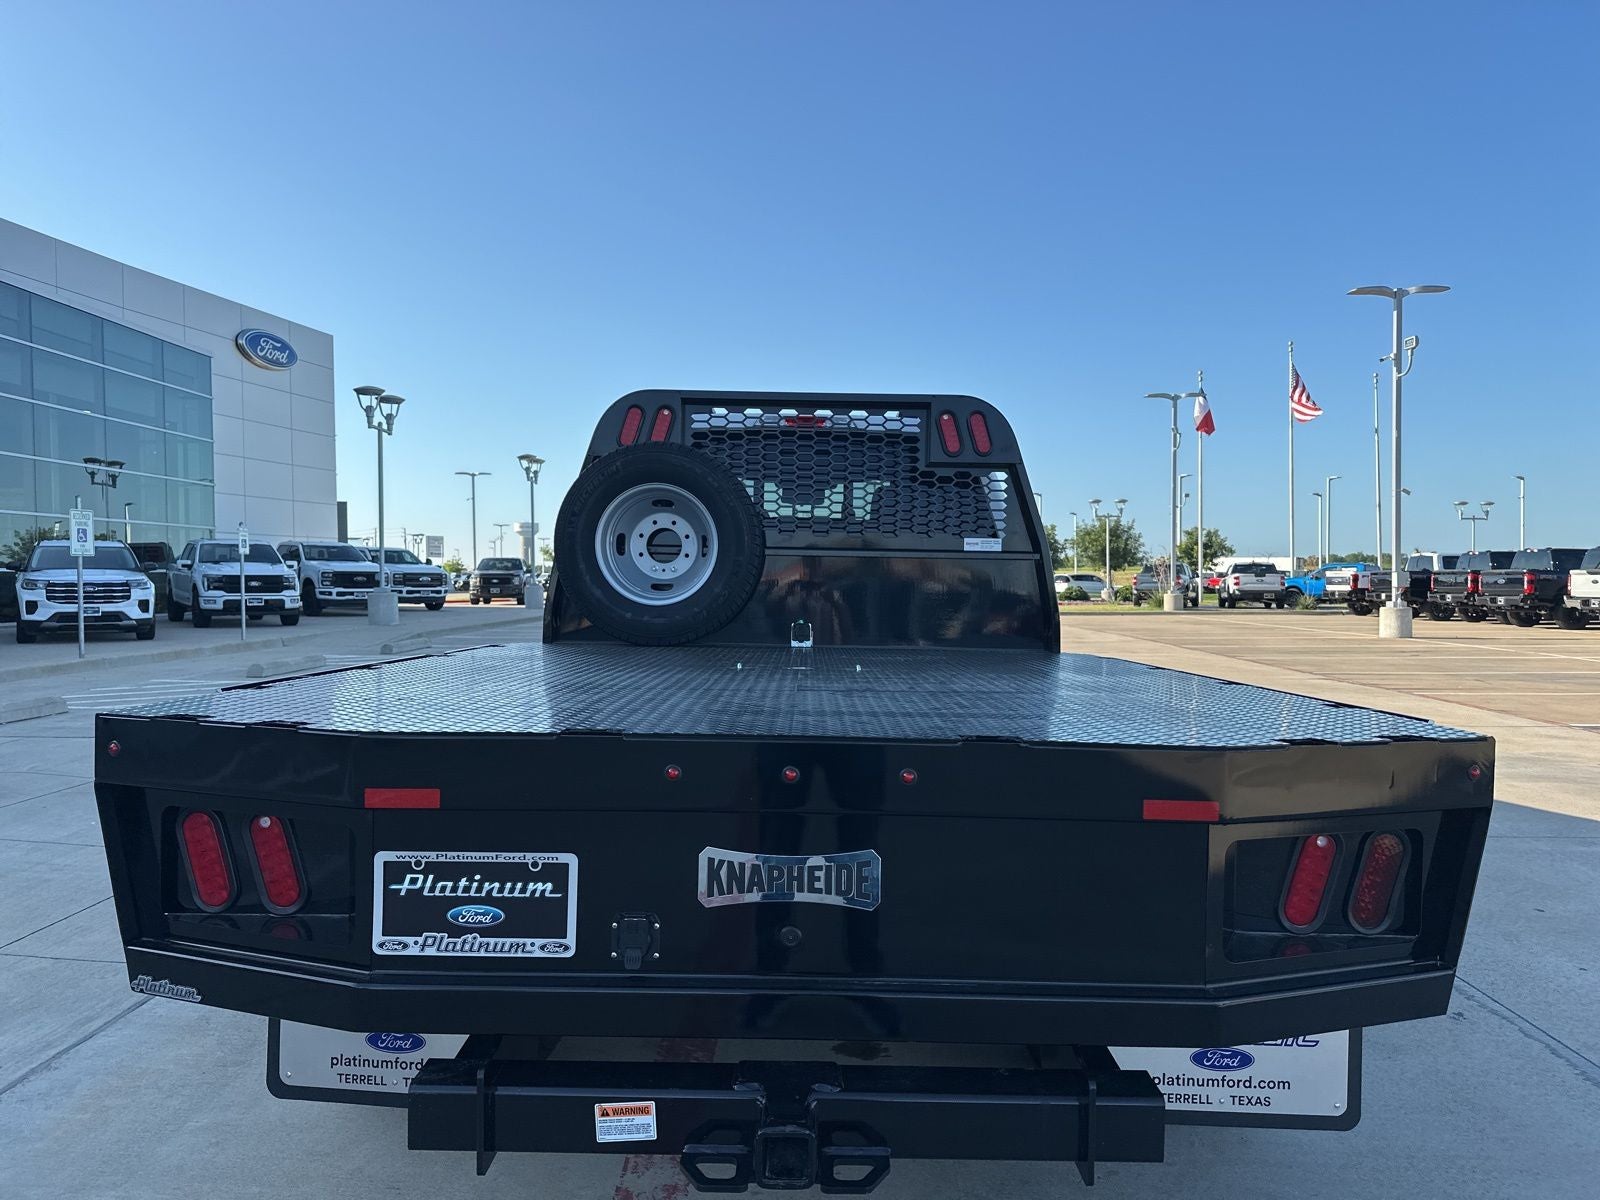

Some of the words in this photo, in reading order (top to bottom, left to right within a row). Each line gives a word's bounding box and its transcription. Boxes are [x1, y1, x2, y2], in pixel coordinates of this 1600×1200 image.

[257, 337, 289, 363] Ford
[395, 853, 559, 862] www.PlatinumFord.com
[389, 874, 565, 898] Platinum
[707, 857, 873, 902] KNAPHEIDE
[458, 908, 494, 924] Ford
[383, 941, 405, 951] Ford
[419, 934, 536, 955] Platinum
[544, 942, 565, 953] Ford
[131, 975, 201, 1002] Platinum
[378, 1033, 413, 1049] Ford
[1203, 1050, 1241, 1067] Ford
[337, 1073, 387, 1086] TERRELL
[1152, 1073, 1291, 1090] platinumford.com
[1229, 1095, 1271, 1107] TEXAS
[611, 1107, 650, 1116] WARNING
